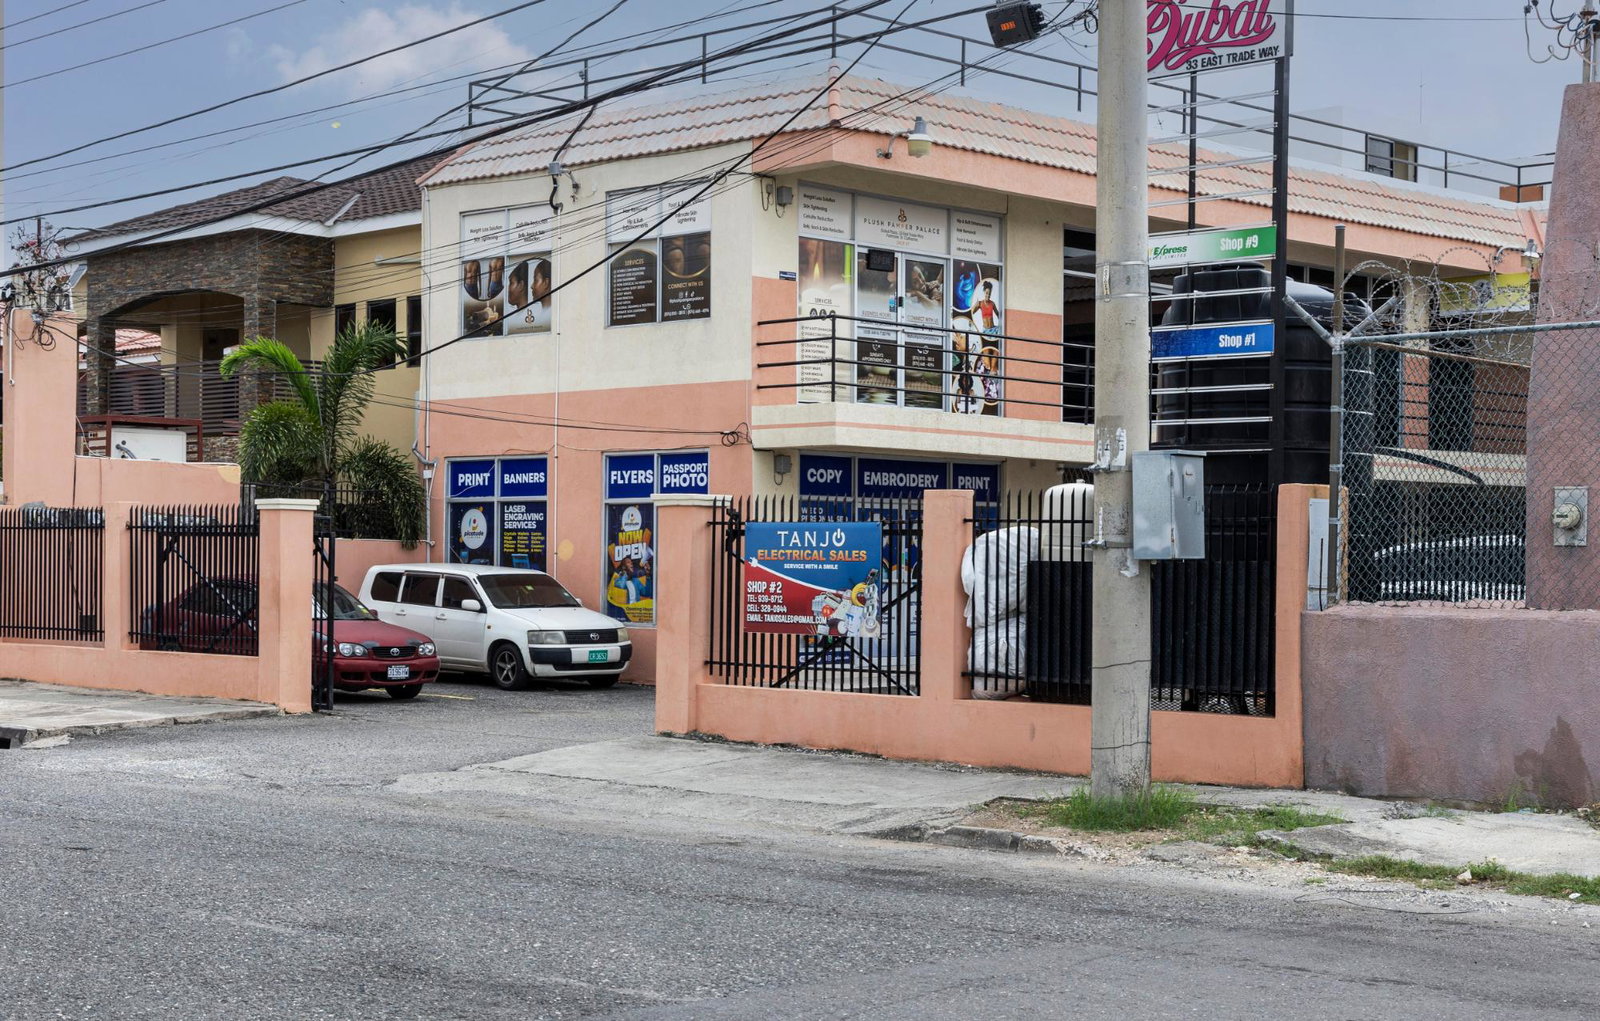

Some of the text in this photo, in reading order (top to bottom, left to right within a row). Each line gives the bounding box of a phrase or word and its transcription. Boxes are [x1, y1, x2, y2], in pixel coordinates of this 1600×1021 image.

[1186, 45, 1280, 70] 33 EAST TRADE WAY
[864, 218, 940, 234] PLUSH PAMPER PALACE
[1220, 235, 1258, 252] Shop #9
[1219, 332, 1256, 348] Shop #1
[663, 463, 707, 474] PASSPORT
[807, 468, 842, 483] COPY
[458, 473, 490, 486] PRINT
[504, 472, 545, 484] BANNERS
[611, 470, 653, 484] FLYERS
[663, 474, 707, 487] PHOTO
[864, 471, 939, 488] EMBROIDERY
[958, 476, 990, 490] PRINT
[619, 530, 643, 545] NOW
[777, 528, 845, 547] TANJO
[615, 542, 647, 561] OPEN
[757, 550, 867, 561] ELECTRICAL SALES
[747, 581, 782, 593] SHOP #2
